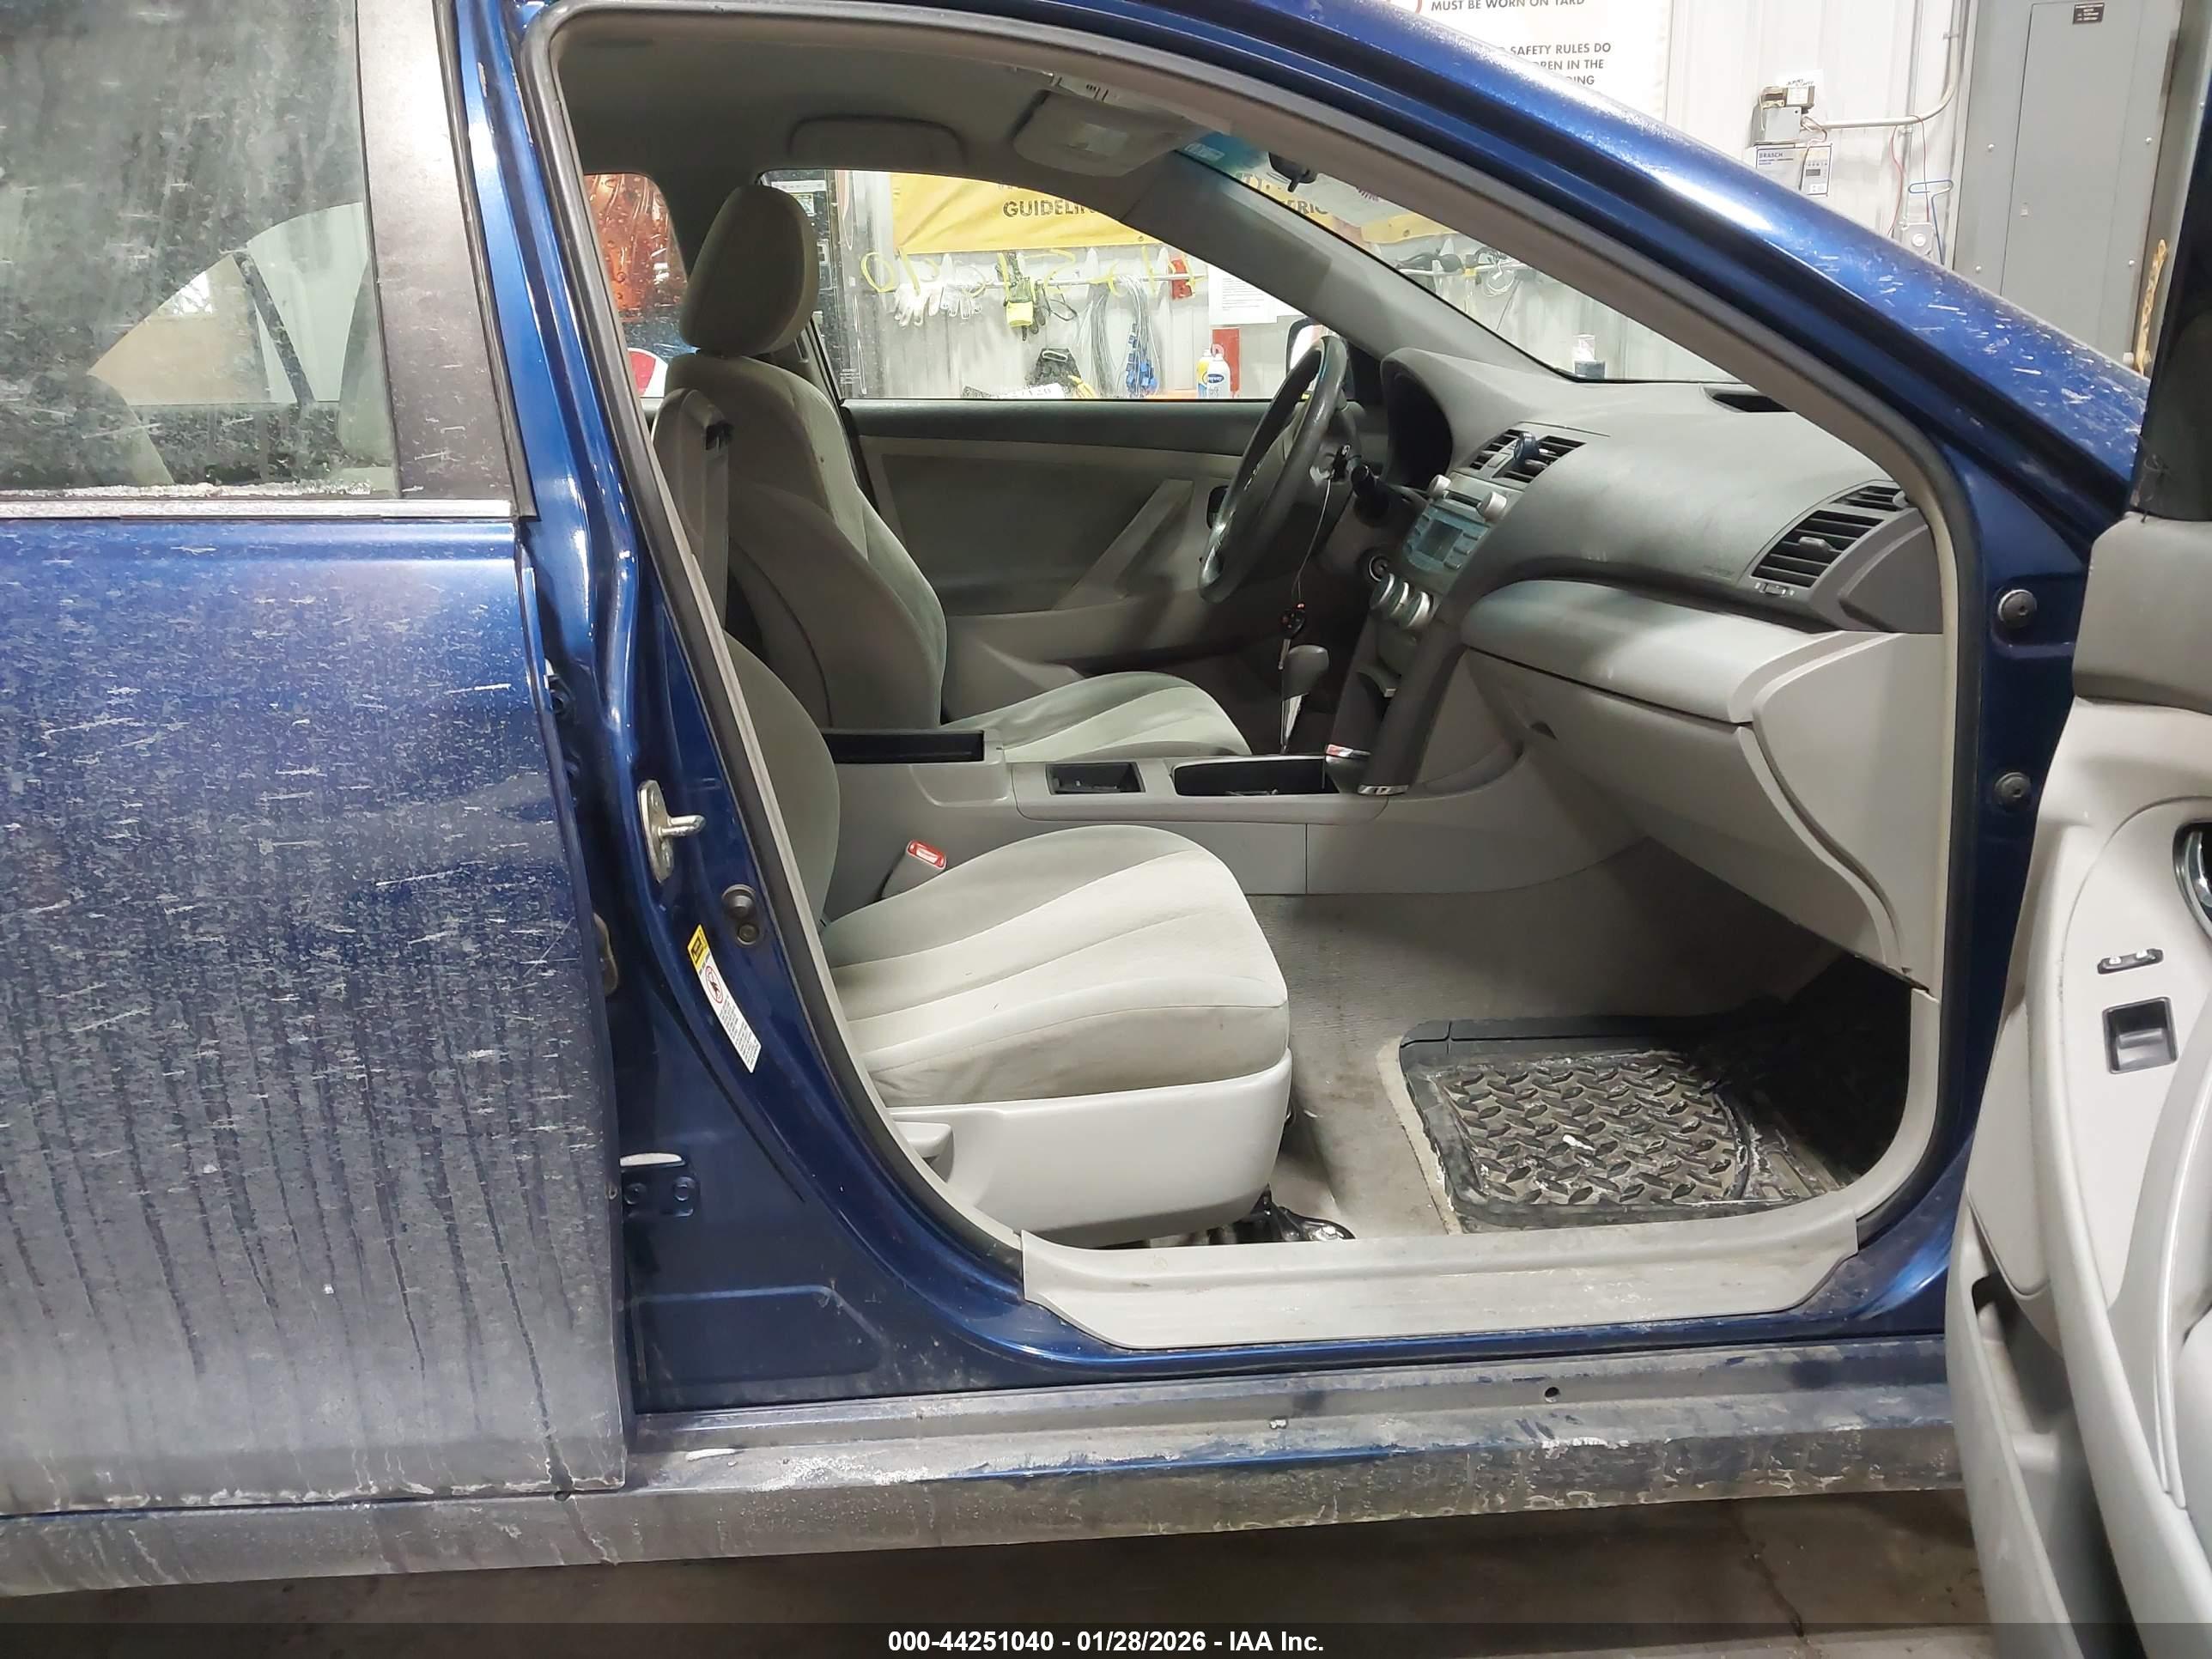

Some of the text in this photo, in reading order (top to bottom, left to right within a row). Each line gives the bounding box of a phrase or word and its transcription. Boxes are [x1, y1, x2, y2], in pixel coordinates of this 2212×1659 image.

[1431, 1, 1462, 11] MUST
[1468, 0, 1481, 9] BE
[1486, 0, 1526, 9] WORN
[1510, 44, 1552, 55] SAFETY
[1555, 43, 1590, 54] RULES
[1594, 42, 1612, 53] DO
[1567, 59, 1580, 70] IN
[1583, 59, 1604, 70] THE
